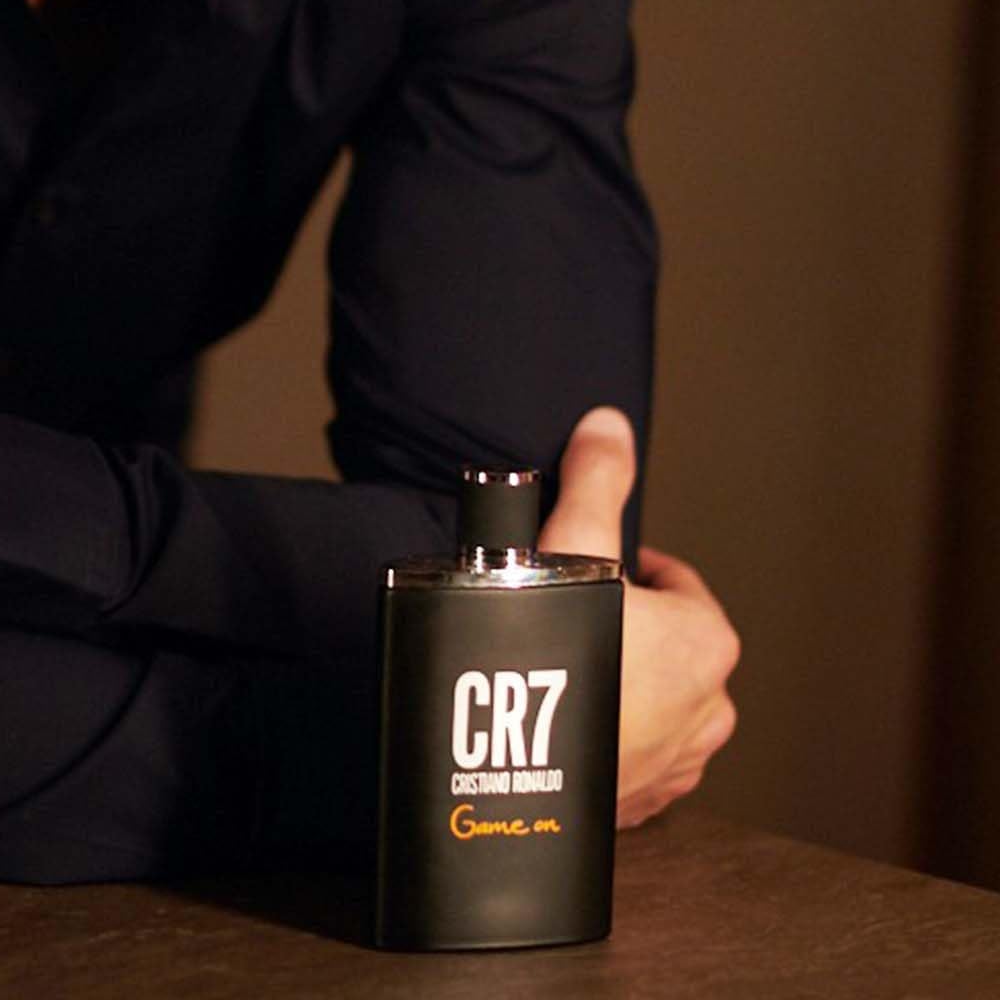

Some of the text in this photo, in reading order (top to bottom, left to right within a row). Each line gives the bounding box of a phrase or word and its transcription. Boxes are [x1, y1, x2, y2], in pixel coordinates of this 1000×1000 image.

[452, 669, 568, 769] CR7
[451, 769, 563, 795] CRISTIANO RONALDO
[450, 803, 562, 840] Game on
